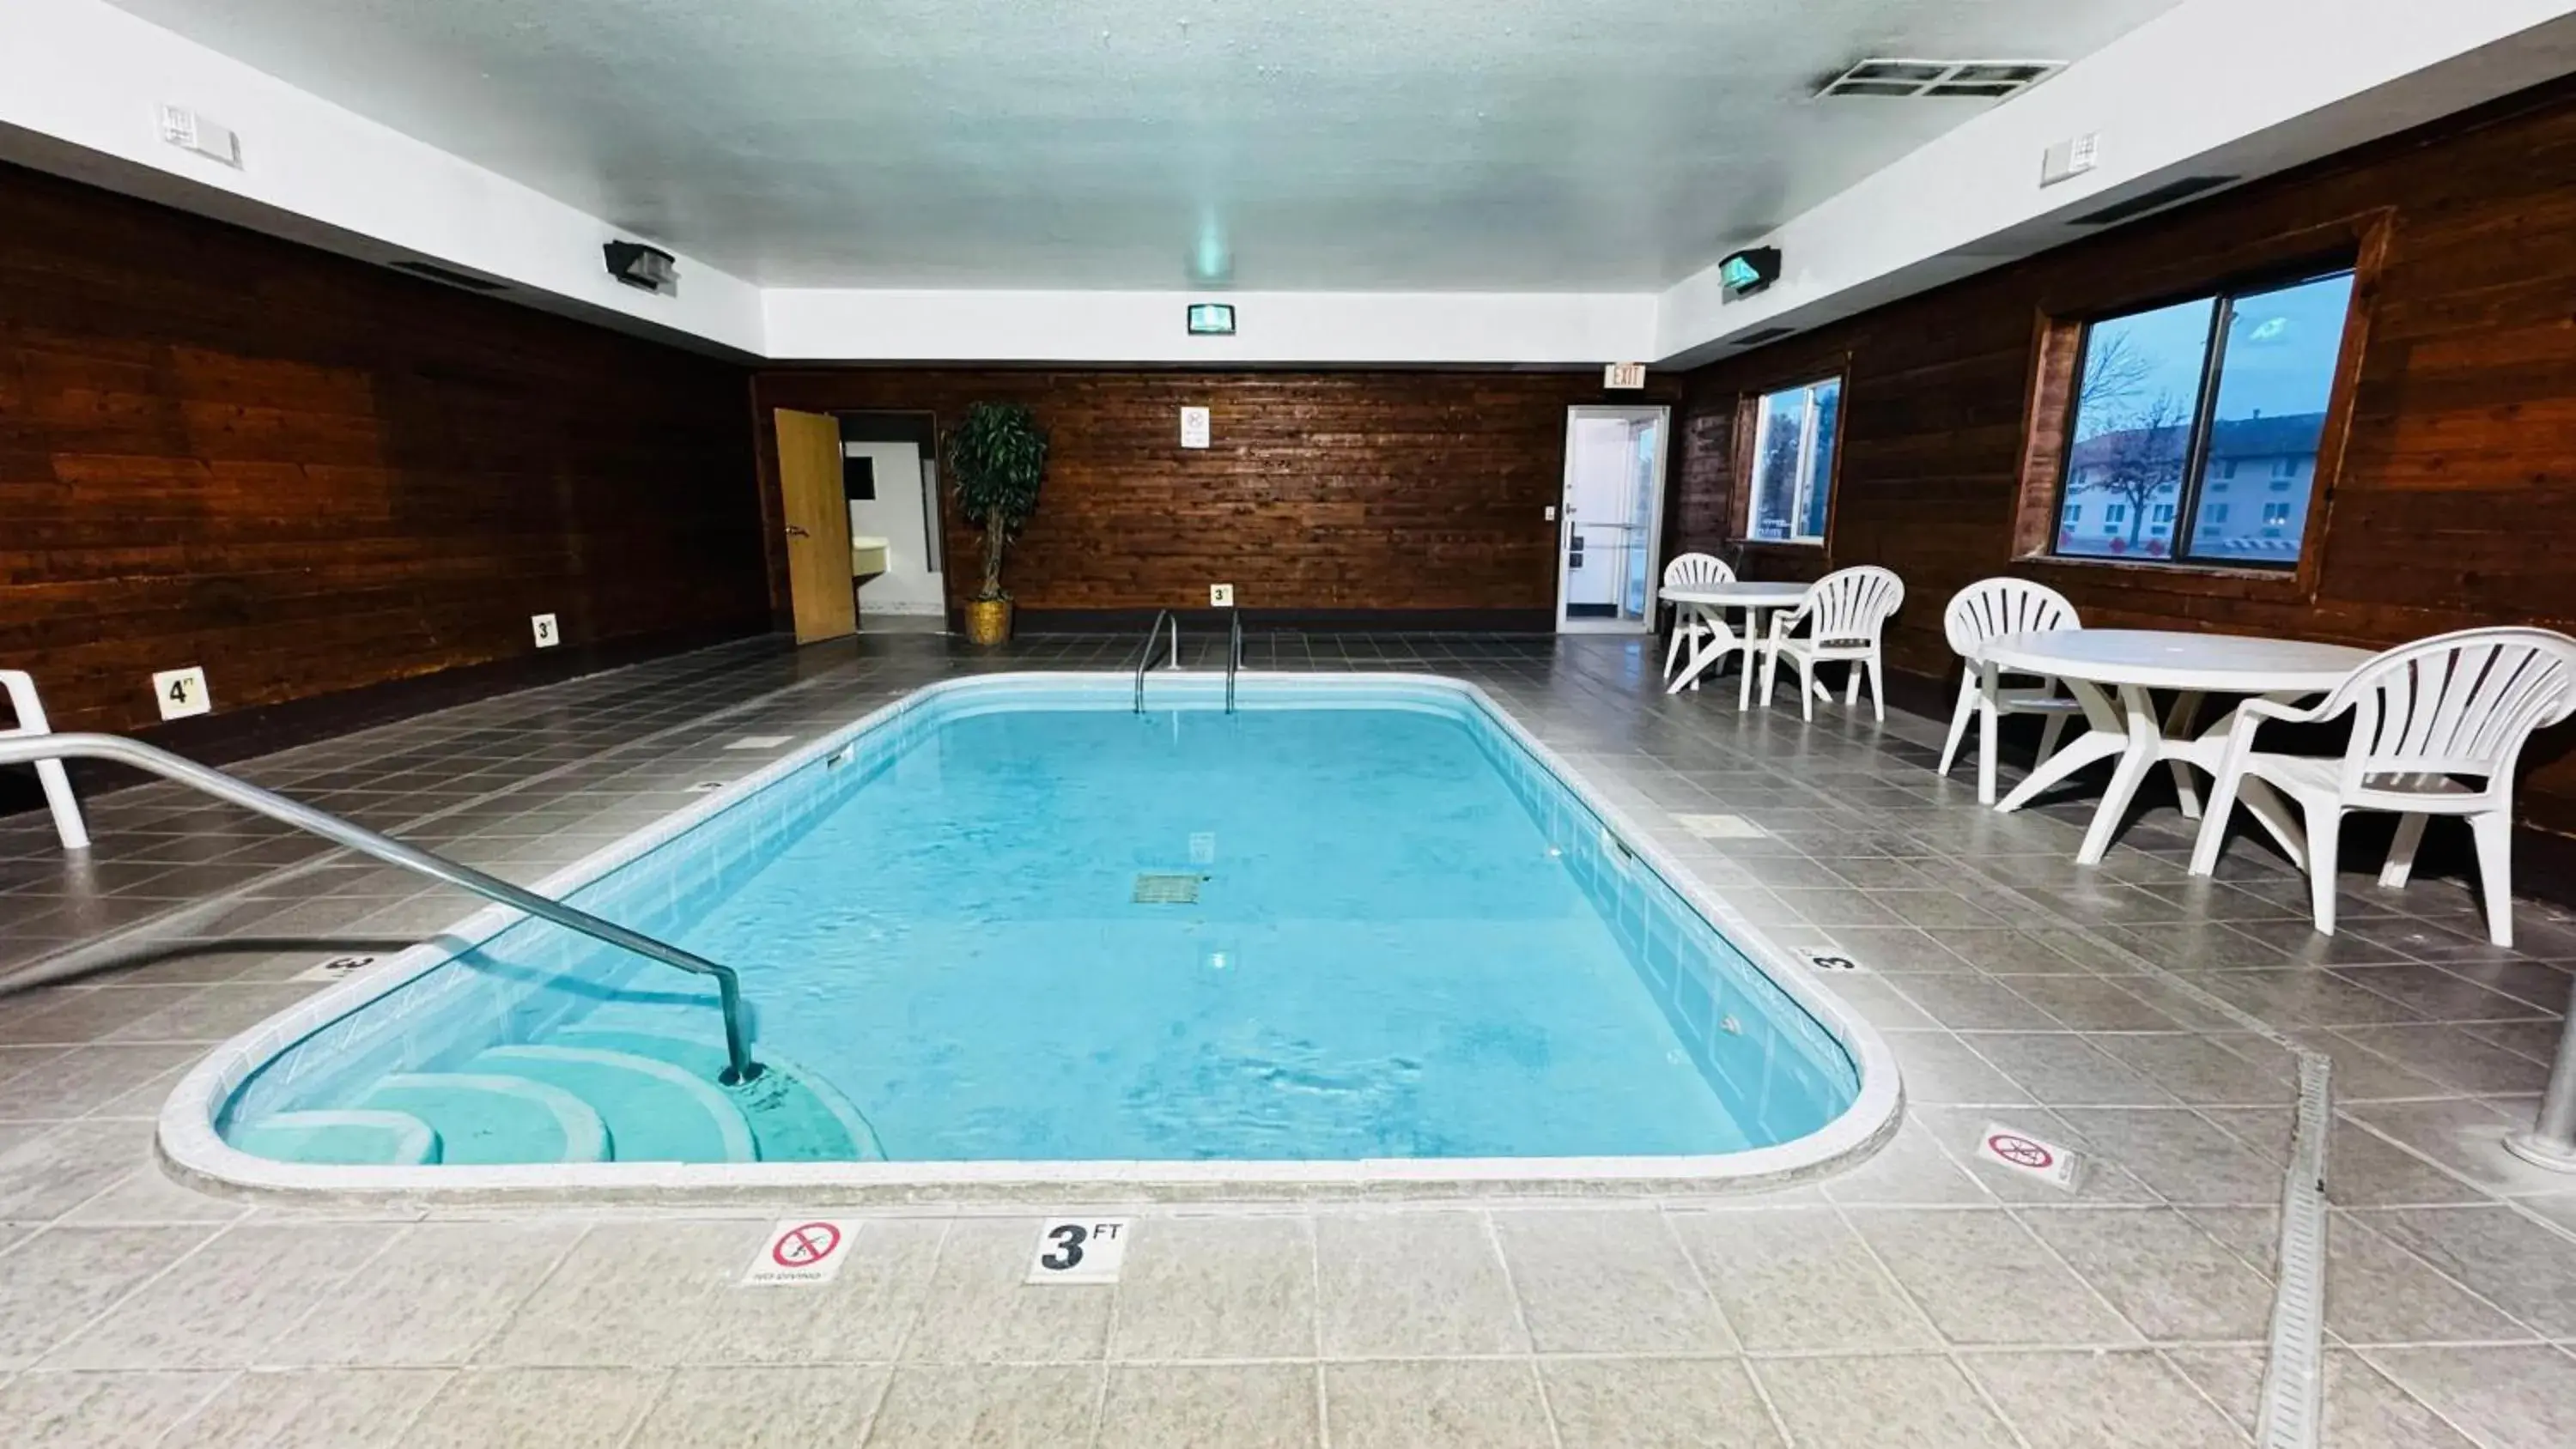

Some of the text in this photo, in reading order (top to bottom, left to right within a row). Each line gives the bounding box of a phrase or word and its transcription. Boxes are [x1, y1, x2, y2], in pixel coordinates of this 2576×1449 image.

[1613, 365, 1640, 385] EXIT
[1215, 589, 1223, 600] 3
[538, 622, 548, 640] 3
[170, 680, 186, 704] 4
[1813, 957, 1855, 968] 3
[1042, 1223, 1123, 1270] 3 FT
